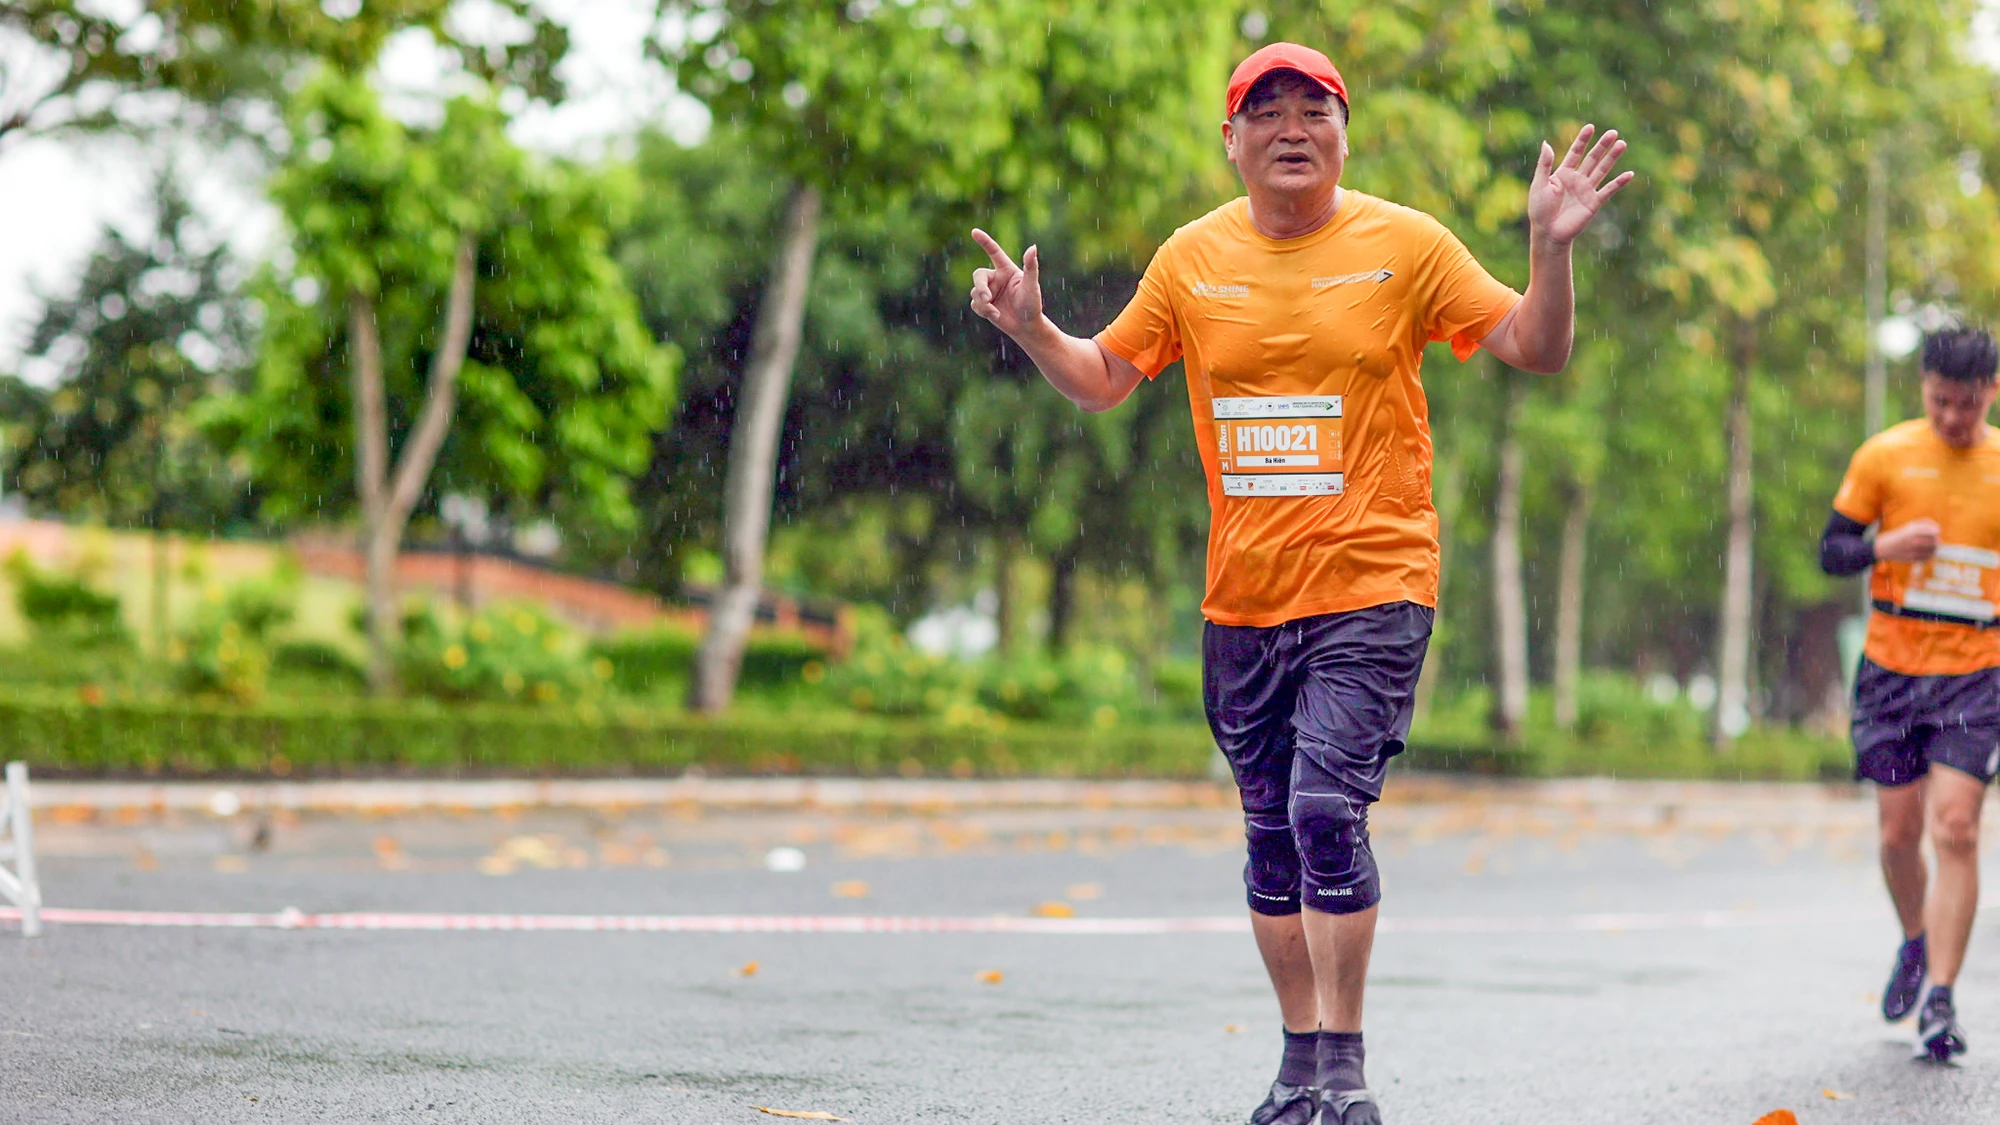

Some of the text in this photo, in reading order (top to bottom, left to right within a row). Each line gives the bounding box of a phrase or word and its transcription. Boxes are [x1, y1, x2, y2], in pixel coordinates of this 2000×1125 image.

[1218, 285, 1249, 293] SHINE
[1219, 424, 1227, 453] 10km
[1236, 425, 1317, 452] H10021
[1317, 887, 1353, 897] AONIJIE
